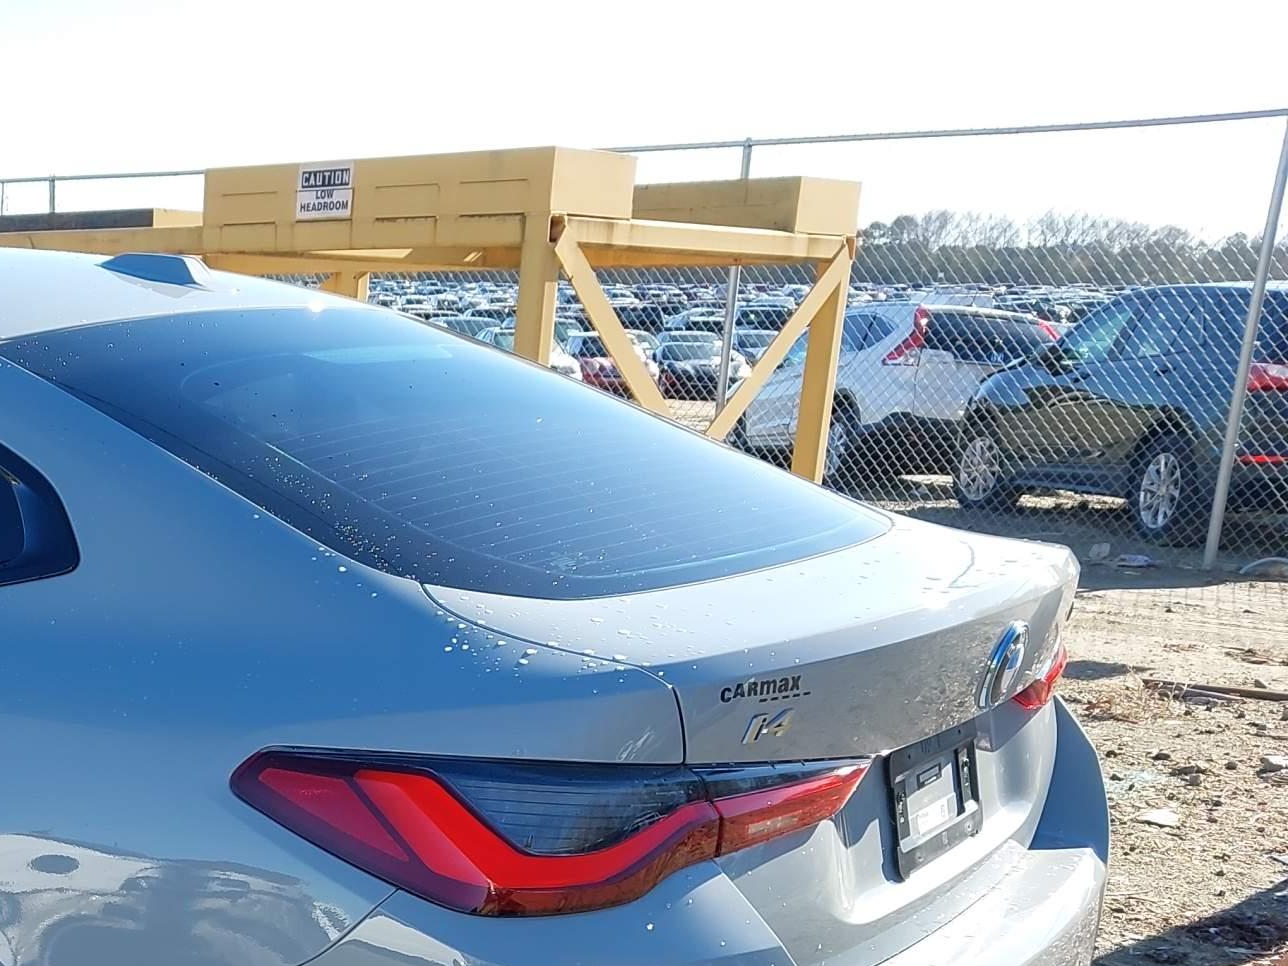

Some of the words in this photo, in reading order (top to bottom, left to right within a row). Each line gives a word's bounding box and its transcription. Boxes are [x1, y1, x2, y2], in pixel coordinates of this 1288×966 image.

[302, 170, 350, 187] CAUTION
[315, 189, 334, 200] LOW
[300, 200, 348, 212] HEADROOM
